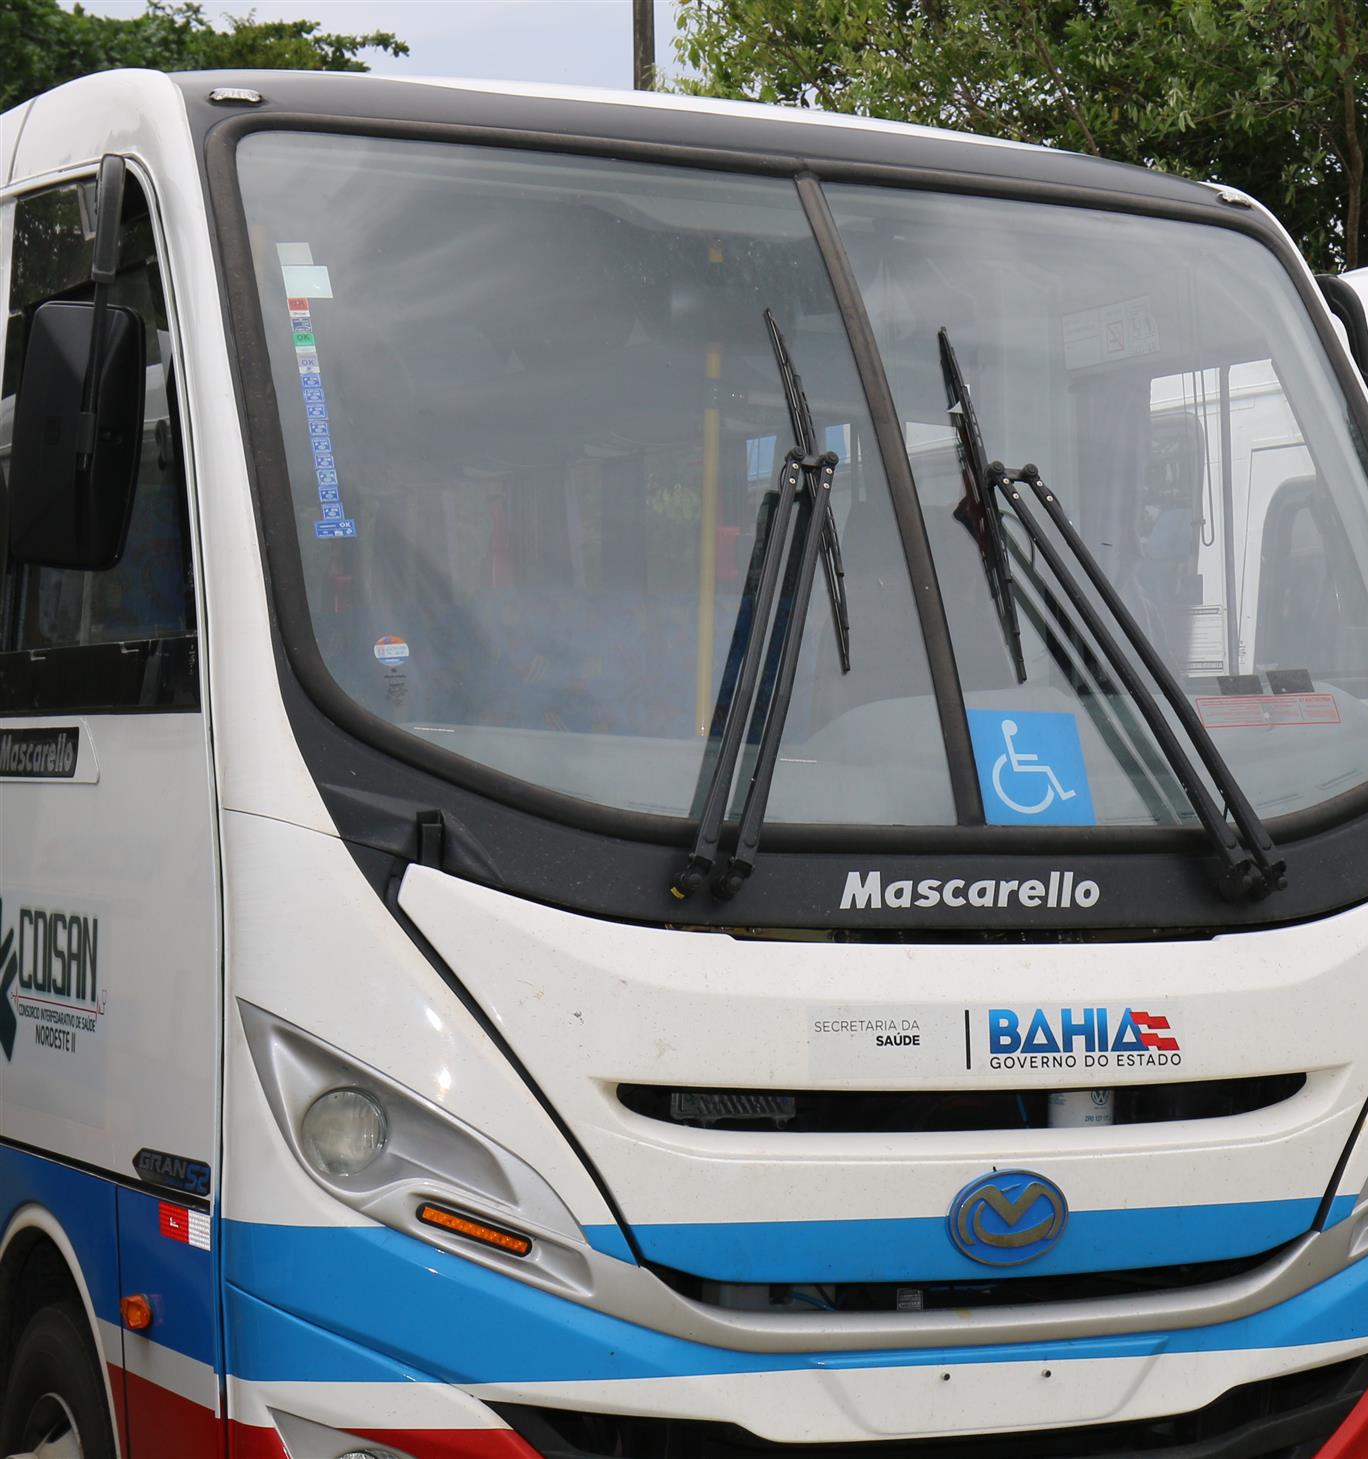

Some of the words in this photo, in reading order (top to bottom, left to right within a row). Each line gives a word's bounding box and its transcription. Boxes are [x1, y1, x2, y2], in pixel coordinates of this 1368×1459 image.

[0, 732, 73, 772] Mascarello
[839, 871, 1100, 909] Mascarello
[19, 908, 98, 1002] COISAN
[35, 1024, 70, 1052] NORDESTE
[814, 1020, 898, 1033] SECRETARIA
[901, 1020, 920, 1032] DA
[876, 1033, 921, 1047] SAÚDE
[988, 1008, 1151, 1054] BAHIA
[990, 1055, 1077, 1070] GOVERNO
[1084, 1055, 1109, 1068] DO
[1117, 1053, 1182, 1067] ESTADO
[138, 1151, 188, 1179] GRAN
